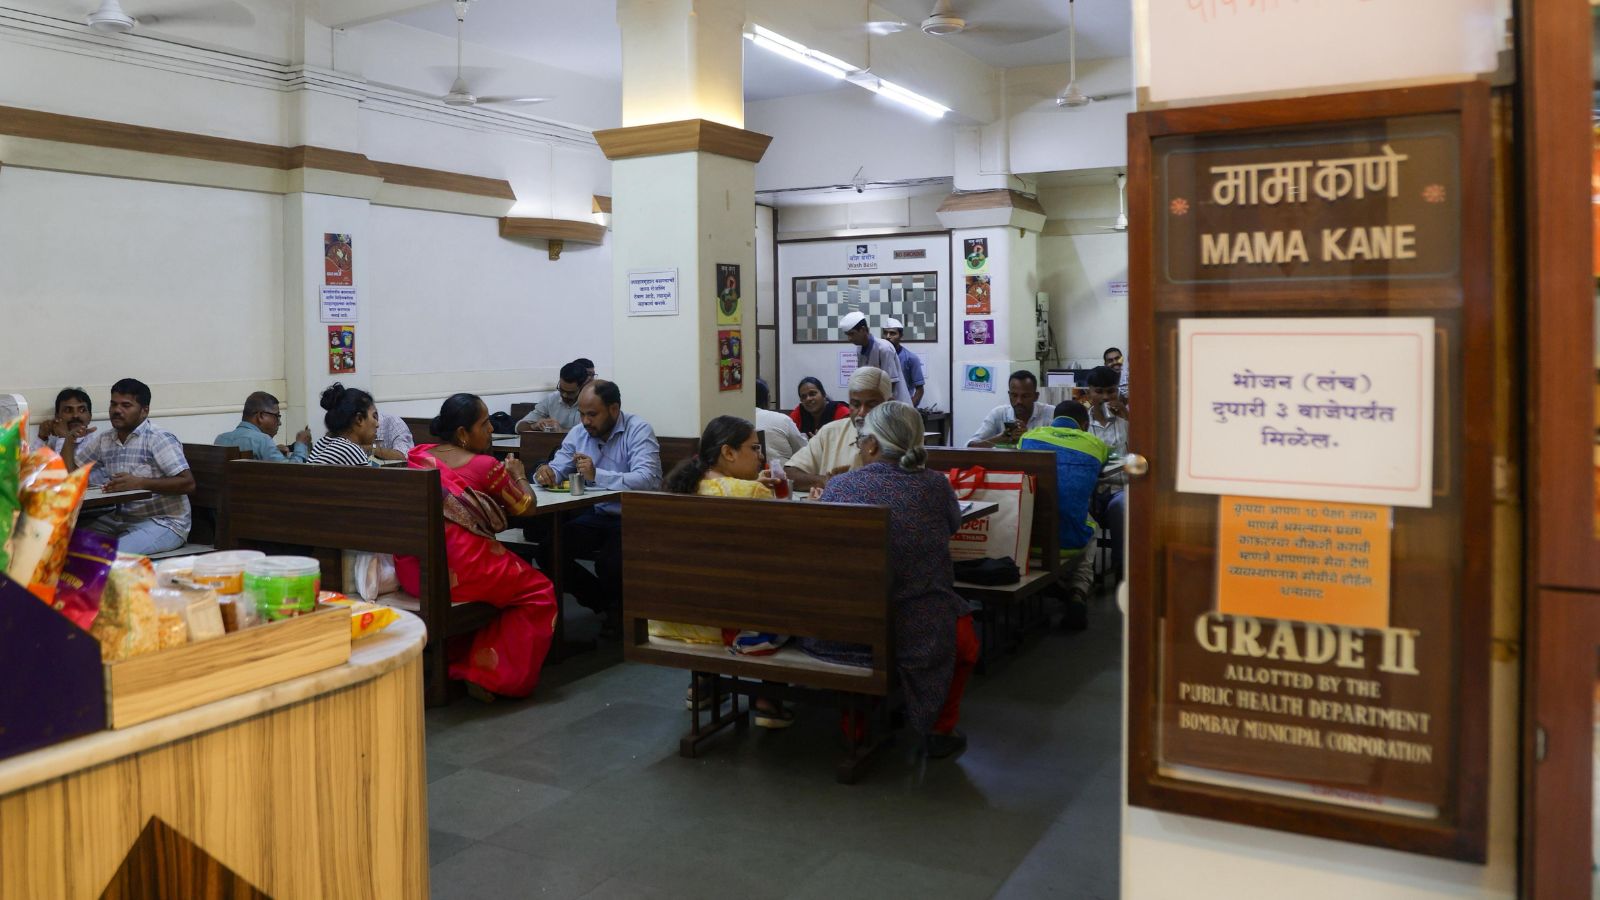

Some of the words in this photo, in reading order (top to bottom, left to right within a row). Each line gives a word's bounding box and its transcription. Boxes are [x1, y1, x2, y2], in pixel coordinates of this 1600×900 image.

[1210, 160, 1314, 206] मामा
[1315, 144, 1408, 200] काणे
[1200, 229, 1309, 266] MAMA
[1321, 224, 1417, 262] KANE
[1233, 369, 1293, 389] भोजन
[1302, 371, 1372, 393] (लंच)
[1212, 398, 1266, 423] दुपारी
[1276, 402, 1289, 419] ३
[1195, 611, 1366, 669] GRADE
[1224, 664, 1314, 690] ALLOTTED
[1317, 674, 1342, 693] BY
[1346, 678, 1381, 698] THE
[1179, 682, 1235, 706] PUBLIC
[1236, 688, 1303, 716] HEALTH
[1308, 698, 1431, 734] DEPARTMENT
[1179, 711, 1240, 736] BOMBAY
[1243, 719, 1323, 749] MUNICIPAL
[1326, 732, 1432, 763] CORPORATION
